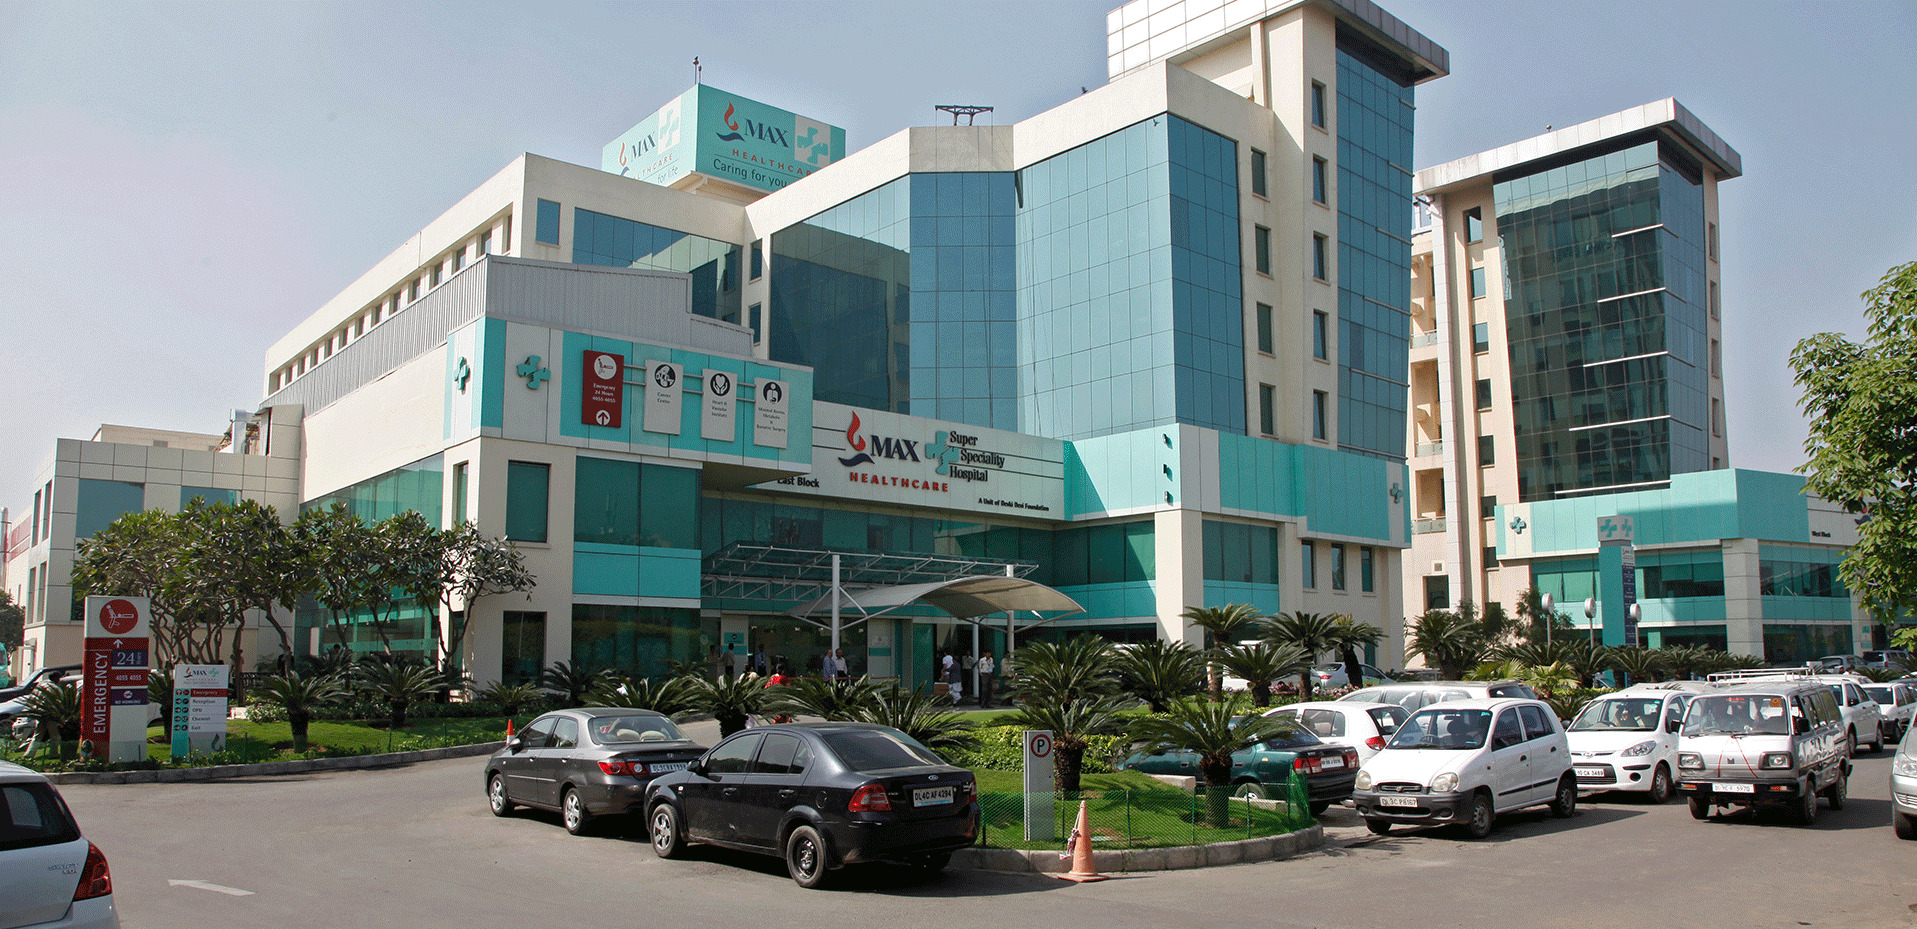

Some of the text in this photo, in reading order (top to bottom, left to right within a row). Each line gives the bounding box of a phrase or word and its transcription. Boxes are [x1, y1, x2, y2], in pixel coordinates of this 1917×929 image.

[744, 118, 789, 148] MAX
[630, 131, 656, 162] MAX
[713, 158, 748, 180] Caring
[751, 169, 767, 183] for
[732, 149, 812, 177] HEALTHCAR
[593, 382, 616, 391] Emergency
[870, 434, 921, 463] MAX
[949, 430, 978, 447] Super
[960, 448, 1005, 468] Speciality
[797, 476, 820, 488] Block
[850, 471, 949, 493] HEALTHCARE
[949, 465, 988, 482] Hospital
[1025, 502, 1049, 511] Foundation
[117, 651, 135, 665] 24
[93, 652, 108, 734] EMERGENCY
[1037, 739, 1045, 753] P
